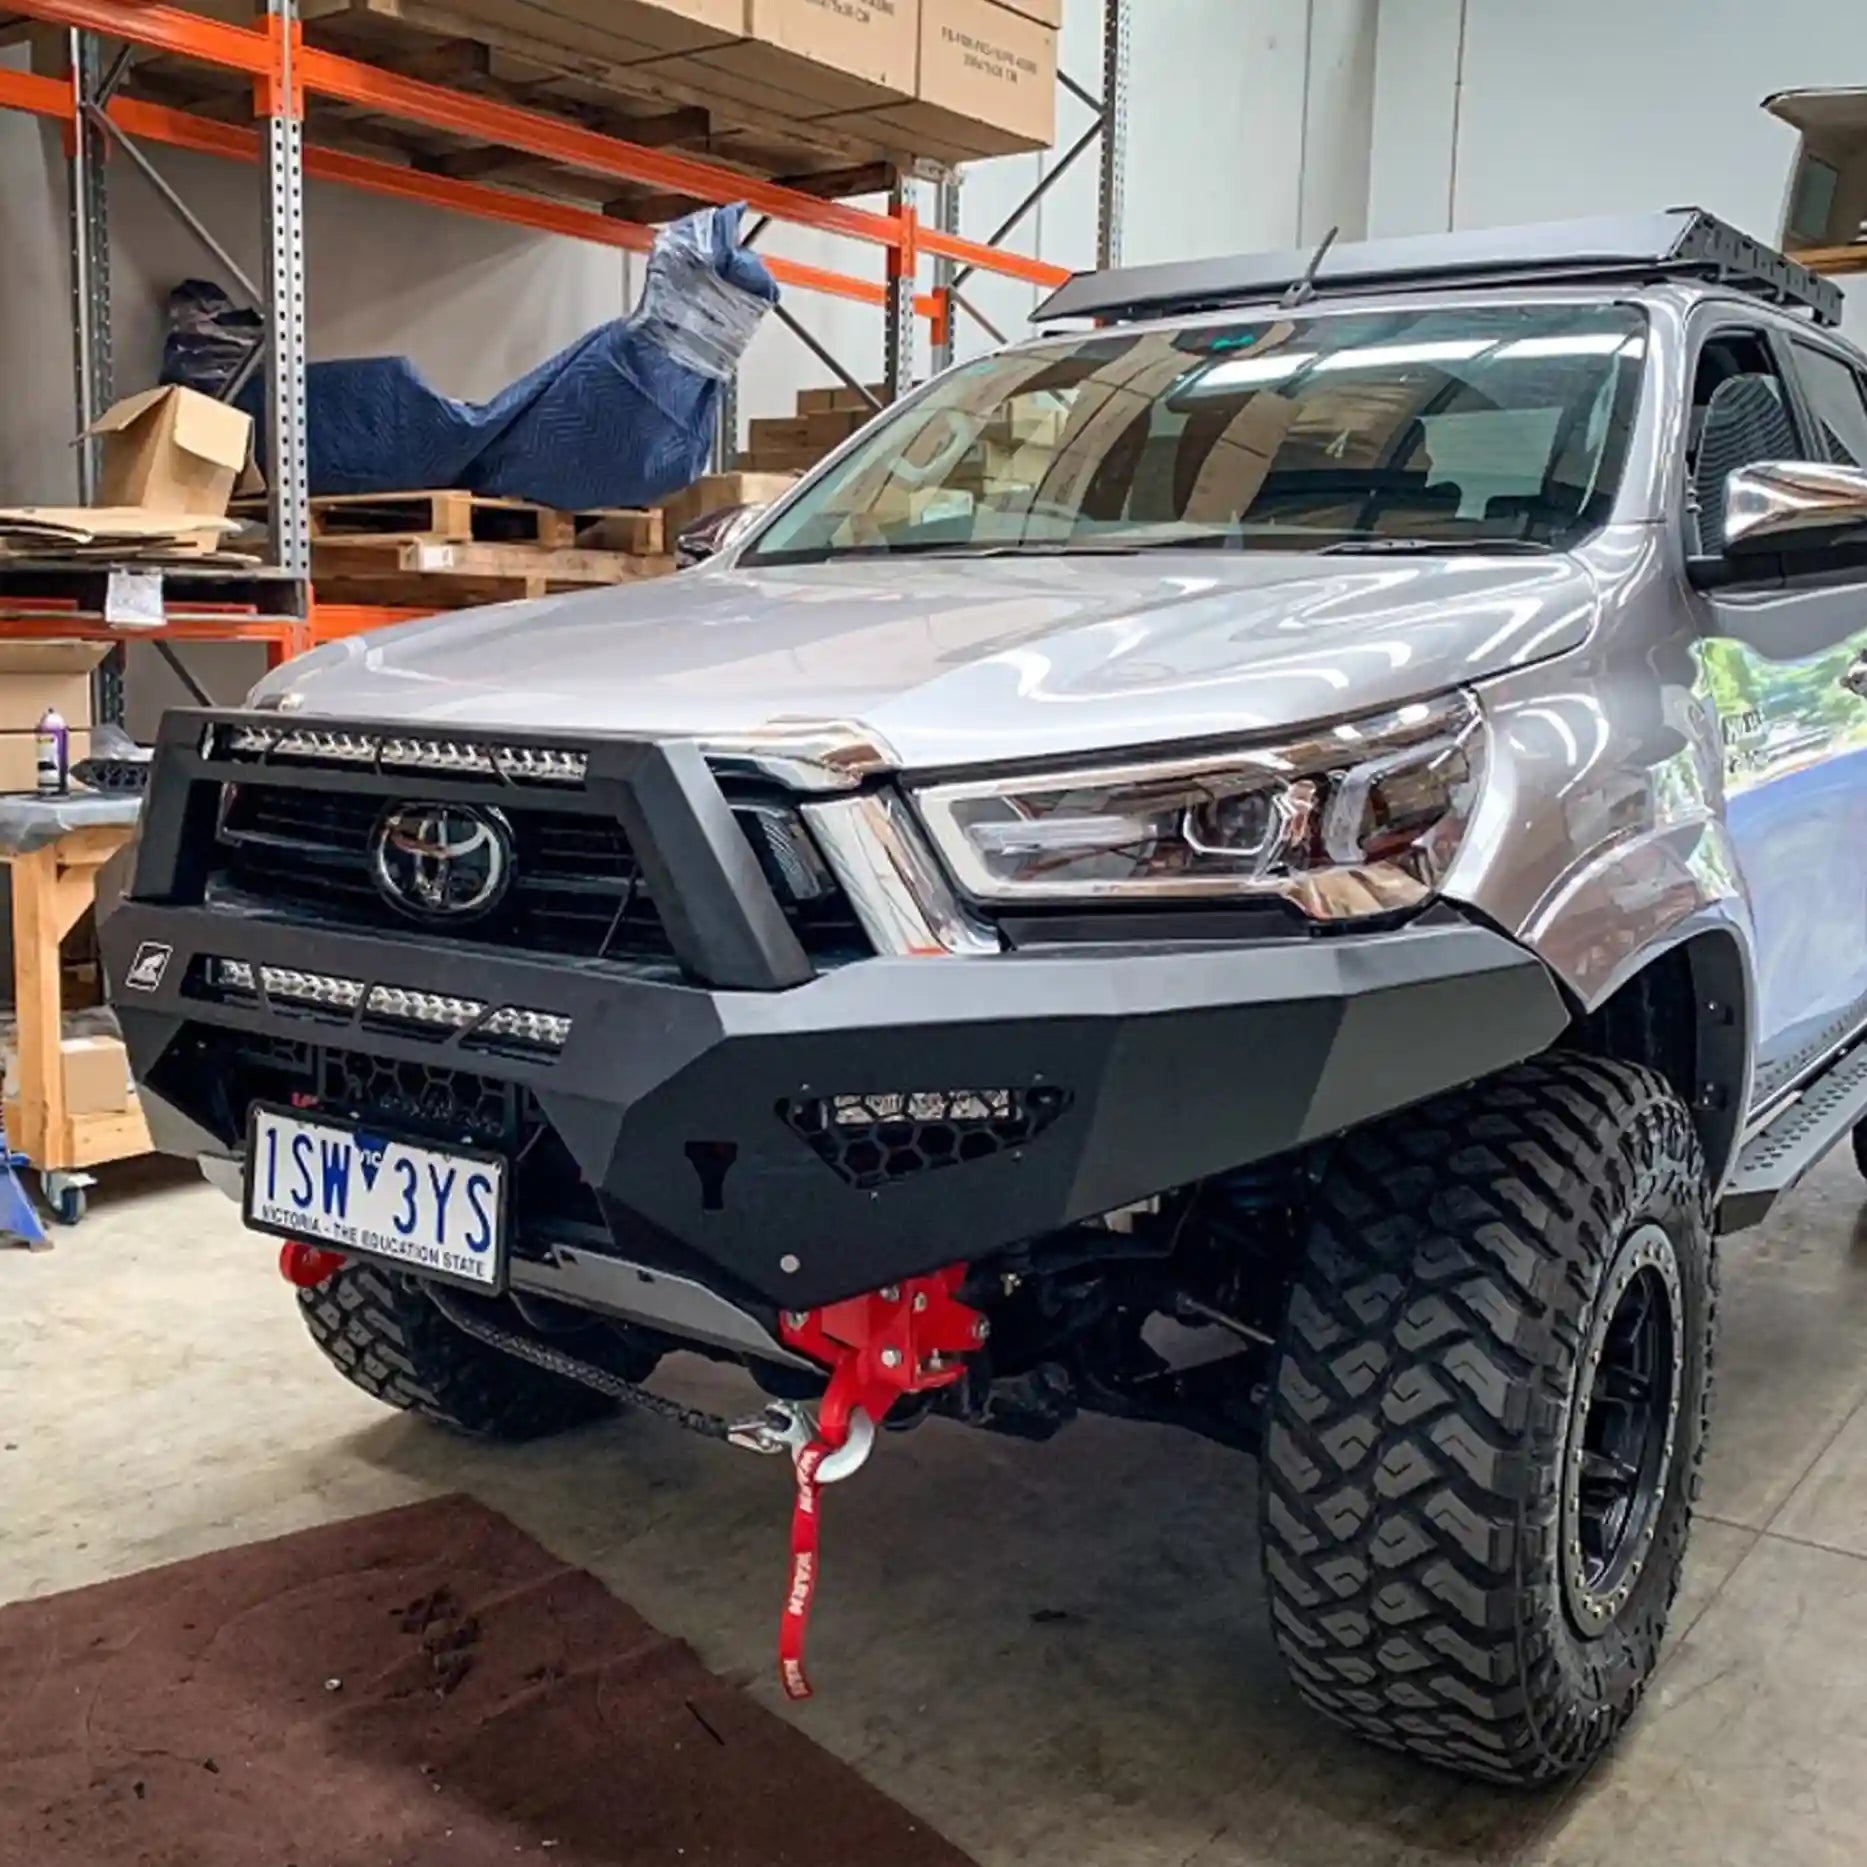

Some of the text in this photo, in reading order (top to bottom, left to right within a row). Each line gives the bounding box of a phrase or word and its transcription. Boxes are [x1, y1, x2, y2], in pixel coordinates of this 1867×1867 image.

[266, 1127, 493, 1253] 1SW 3YS
[261, 1204, 320, 1231] VICTORIA
[333, 1222, 358, 1243] THE
[360, 1230, 440, 1264] EDUCATION
[443, 1251, 486, 1278] STATE
[788, 1551, 812, 1617] WARN
